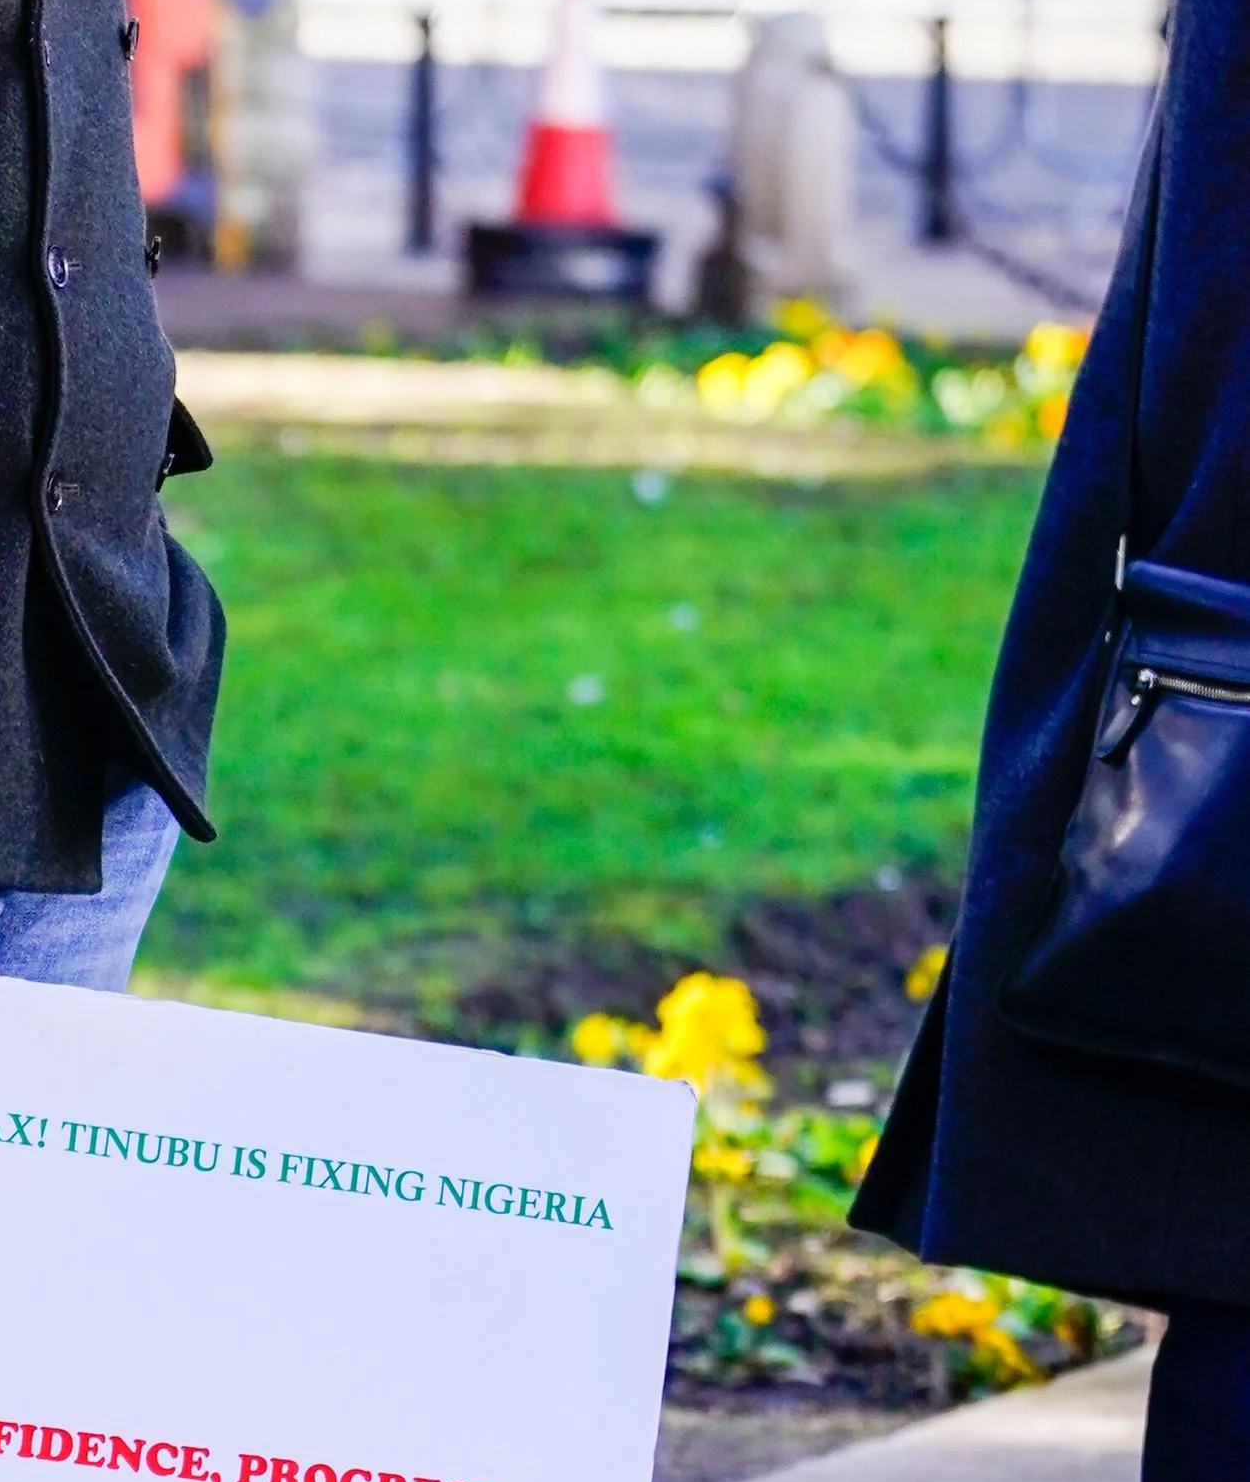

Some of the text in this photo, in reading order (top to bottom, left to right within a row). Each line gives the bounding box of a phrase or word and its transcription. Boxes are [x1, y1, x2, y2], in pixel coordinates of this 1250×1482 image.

[62, 1121, 221, 1172] TINUBU
[230, 1145, 268, 1180] IS
[278, 1153, 425, 1202] FIXING
[438, 1176, 613, 1230] NIGERIA
